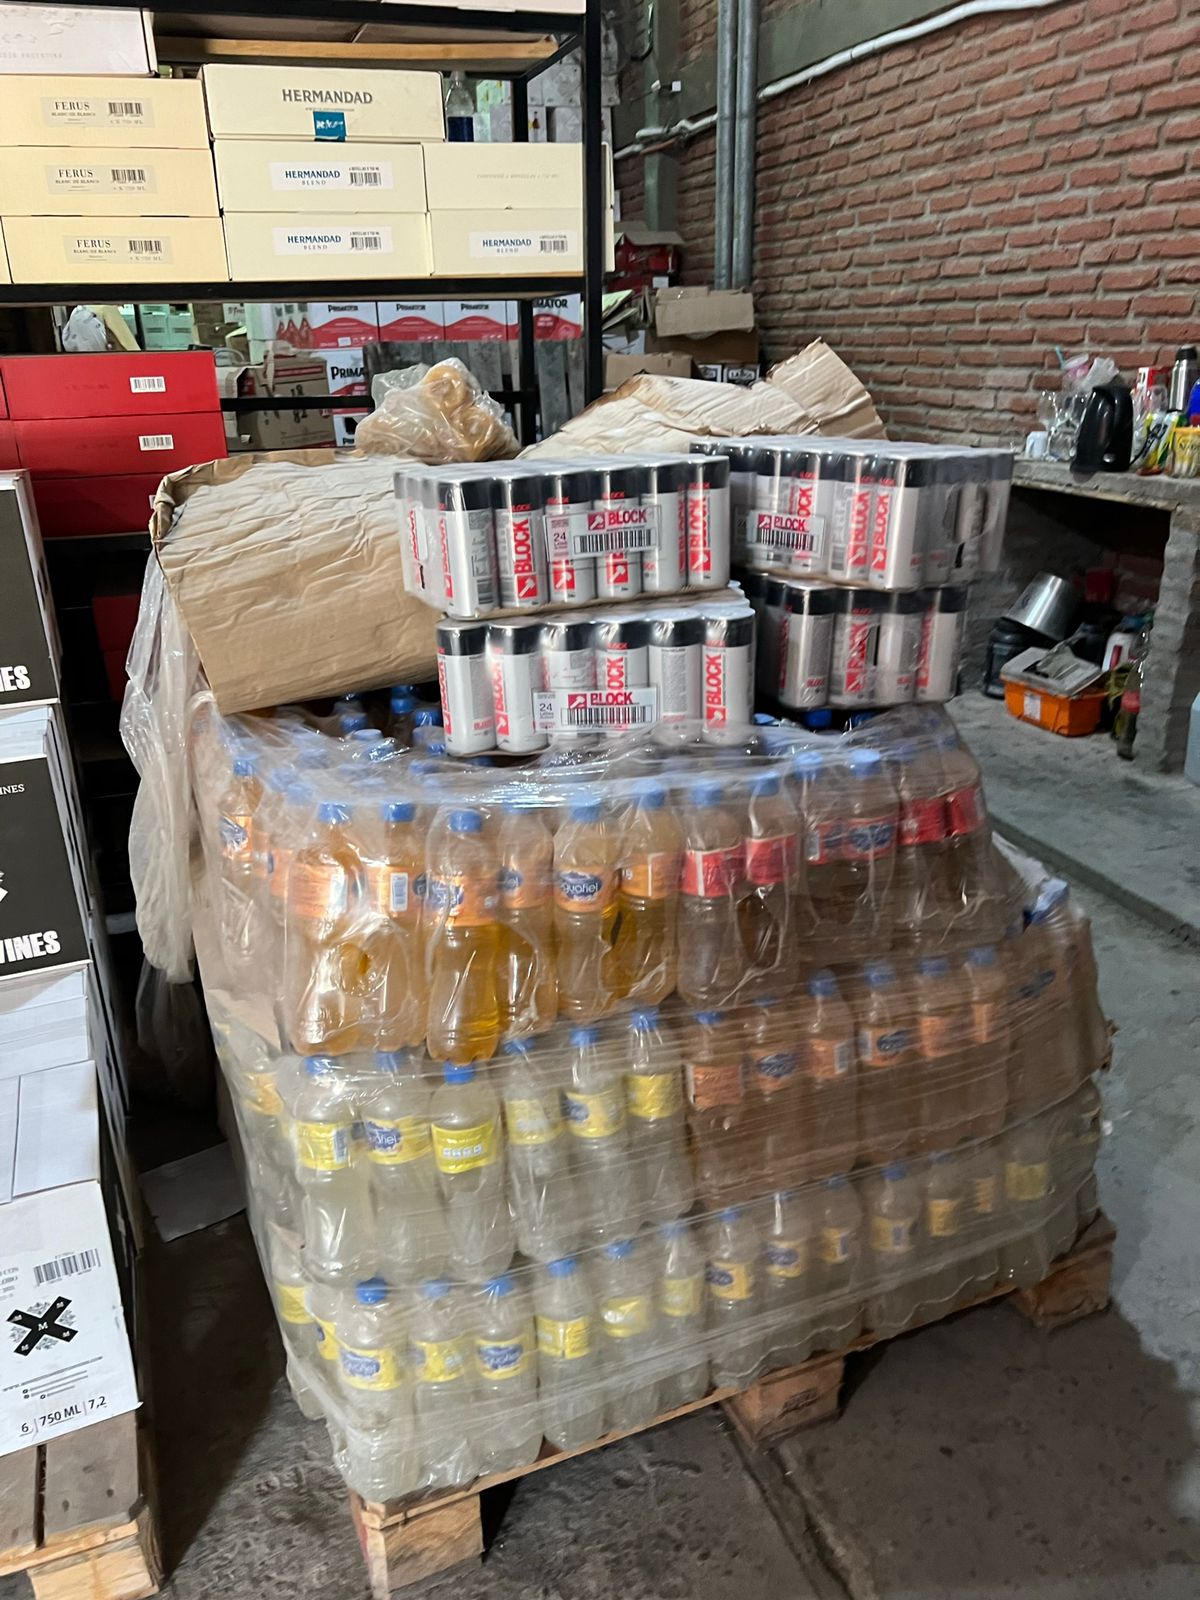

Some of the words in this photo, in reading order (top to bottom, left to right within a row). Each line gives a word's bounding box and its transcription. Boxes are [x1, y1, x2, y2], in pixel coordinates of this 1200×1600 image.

[282, 89, 373, 104] HERMANDAD
[55, 101, 90, 111] FERUS
[59, 169, 94, 178] FERUS
[285, 170, 341, 179] HERMANDAD
[76, 240, 111, 249] FERUS
[287, 235, 342, 244] HERMANDAD
[482, 239, 532, 248] HERMANDAD
[797, 486, 813, 518] OCK
[608, 509, 647, 526] BLOCK
[773, 516, 807, 532] BLOCK
[553, 532, 566, 542] 24
[512, 518, 534, 574] BLOCK
[607, 656, 625, 690] OCK
[705, 654, 722, 706] BLOCK
[591, 692, 634, 706] BLOCK
[539, 703, 553, 712] 24
[38, 1321, 49, 1331] M
[21, 1422, 30, 1433] 6
[40, 1411, 62, 1426] 750
[64, 1404, 82, 1418] ML
[88, 1395, 107, 1410] 7,2
